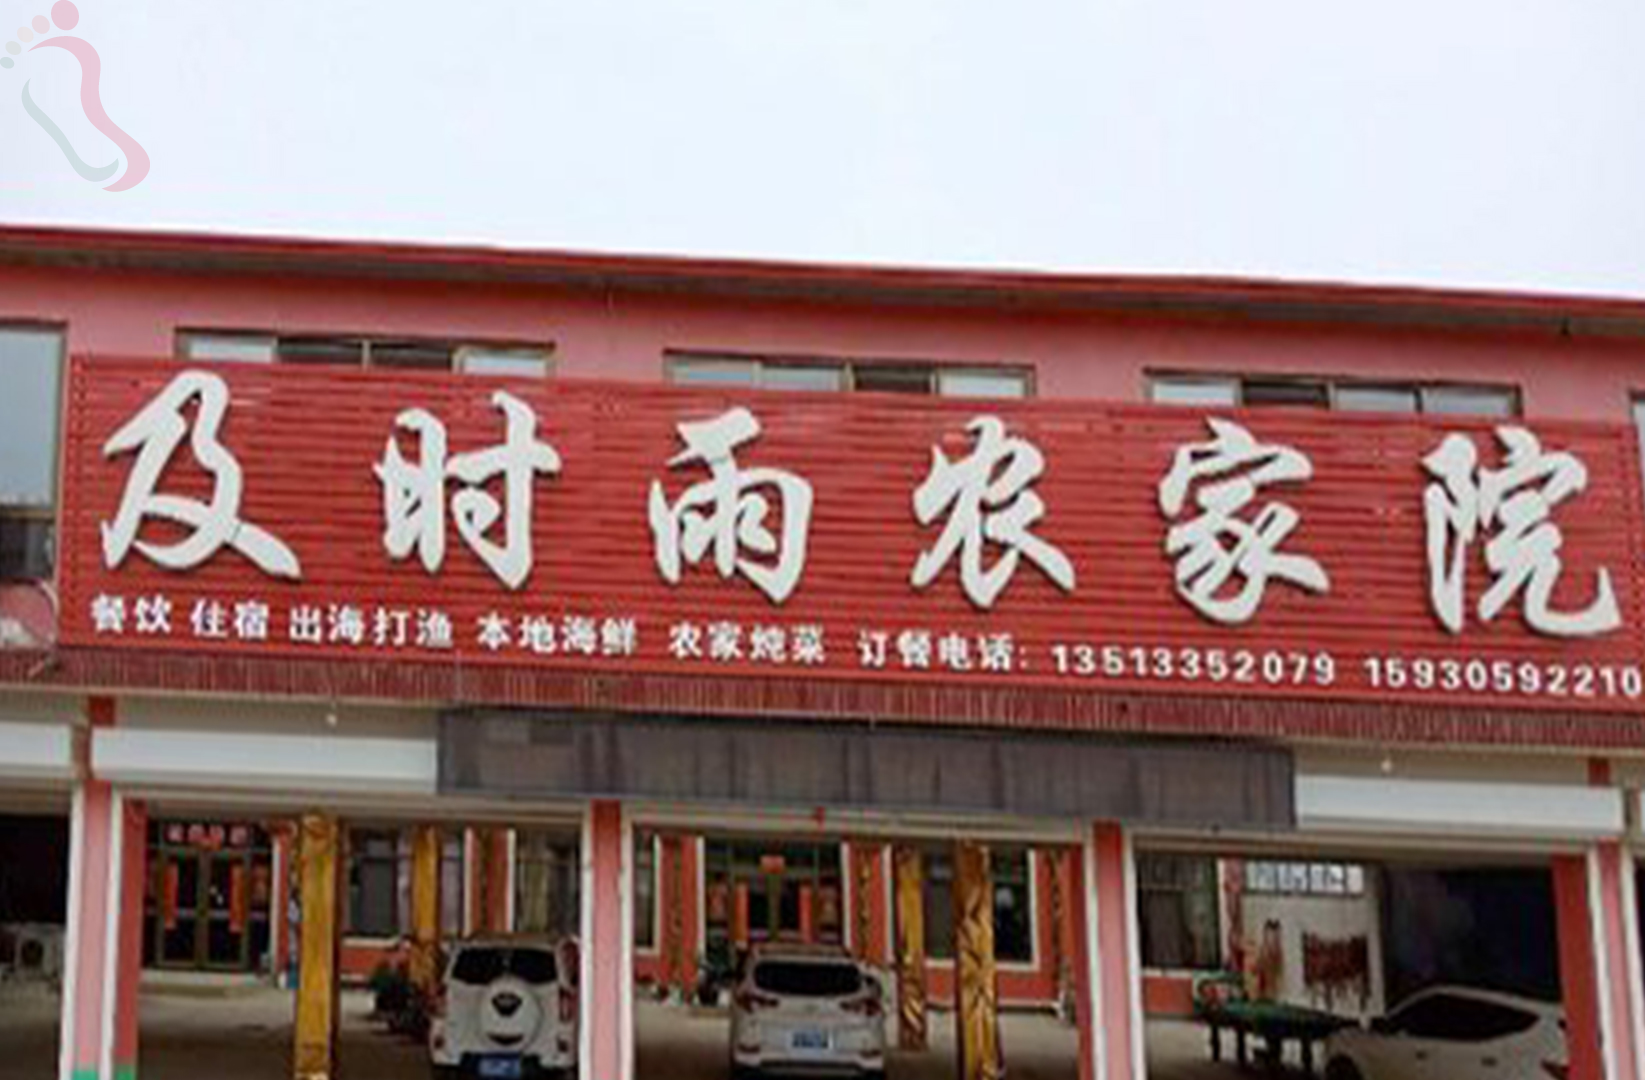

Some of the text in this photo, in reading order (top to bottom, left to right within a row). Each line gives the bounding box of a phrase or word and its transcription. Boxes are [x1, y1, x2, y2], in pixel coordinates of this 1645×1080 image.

[101, 370, 1621, 636] 及时雨农家院
[91, 595, 172, 634] 餐饮
[191, 599, 269, 640] 住宿
[289, 603, 453, 648] 出海打渔
[477, 612, 637, 656] 本地海鲜
[669, 620, 826, 664] 农家炖菜
[1051, 643, 1336, 685] 13513352079
[1364, 656, 1642, 698] 15930592210
